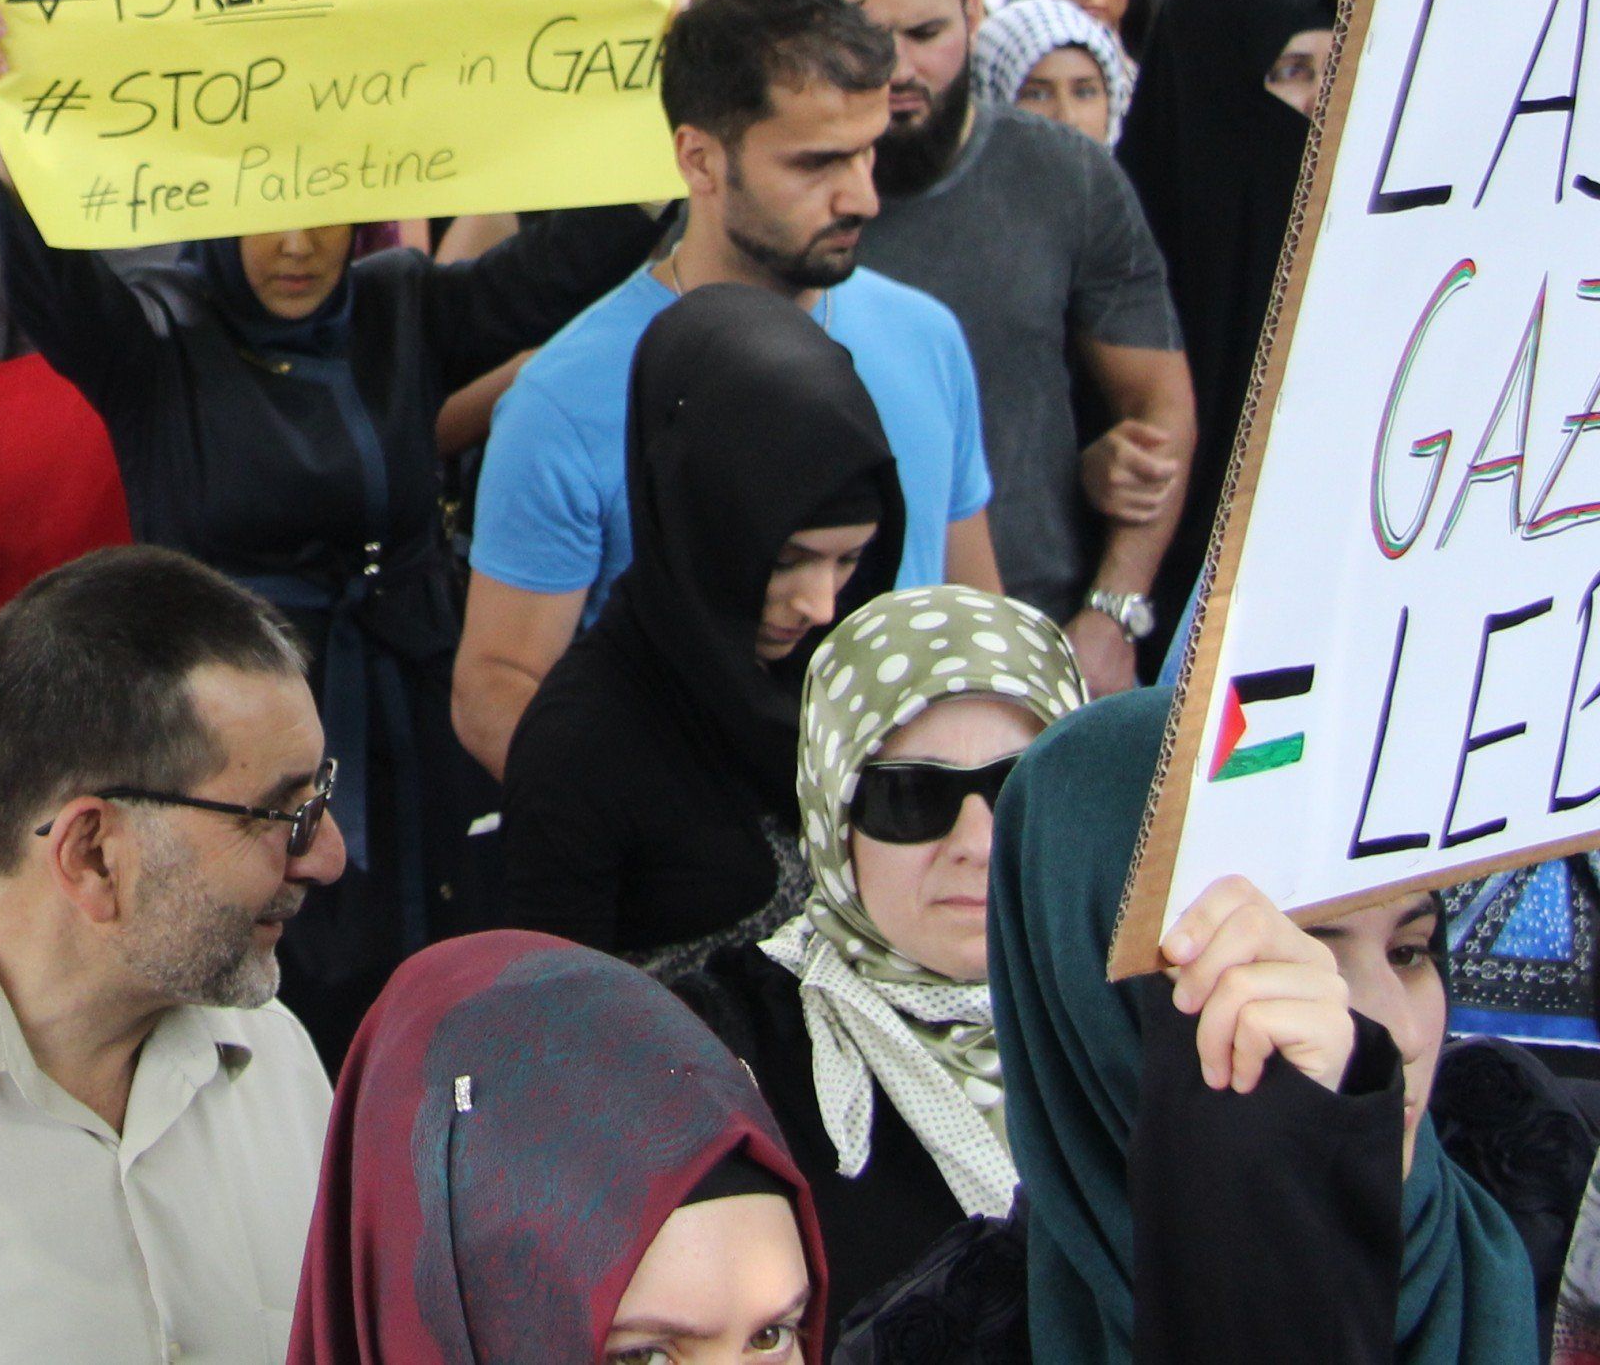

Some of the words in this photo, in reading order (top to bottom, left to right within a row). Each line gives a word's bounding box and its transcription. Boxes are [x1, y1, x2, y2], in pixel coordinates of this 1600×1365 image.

[309, 61, 428, 114] war
[458, 51, 497, 87] in
[80, 161, 211, 232] #free
[233, 143, 459, 208] Palestine
